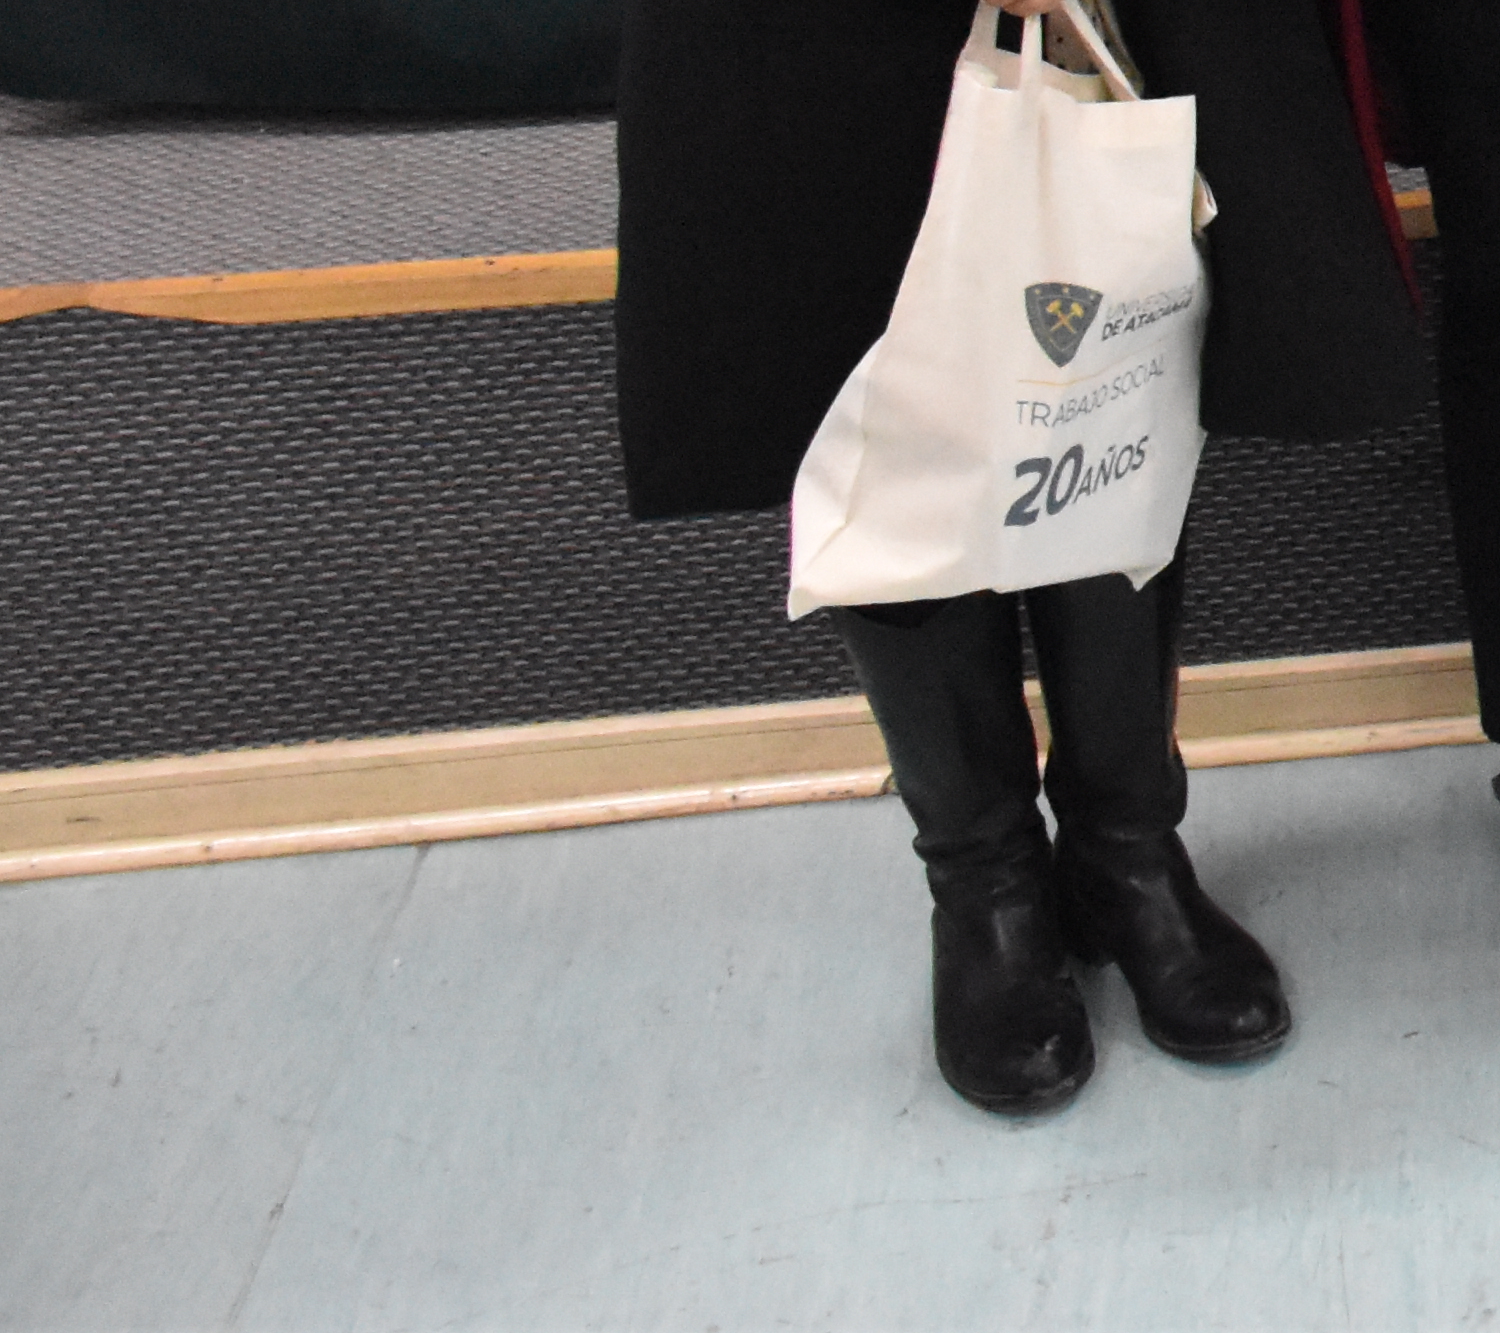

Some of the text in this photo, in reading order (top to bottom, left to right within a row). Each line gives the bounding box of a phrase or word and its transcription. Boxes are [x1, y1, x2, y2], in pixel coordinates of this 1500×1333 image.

[1101, 319, 1123, 342] DE
[1016, 355, 1165, 428] TRABAJO SOCIAL
